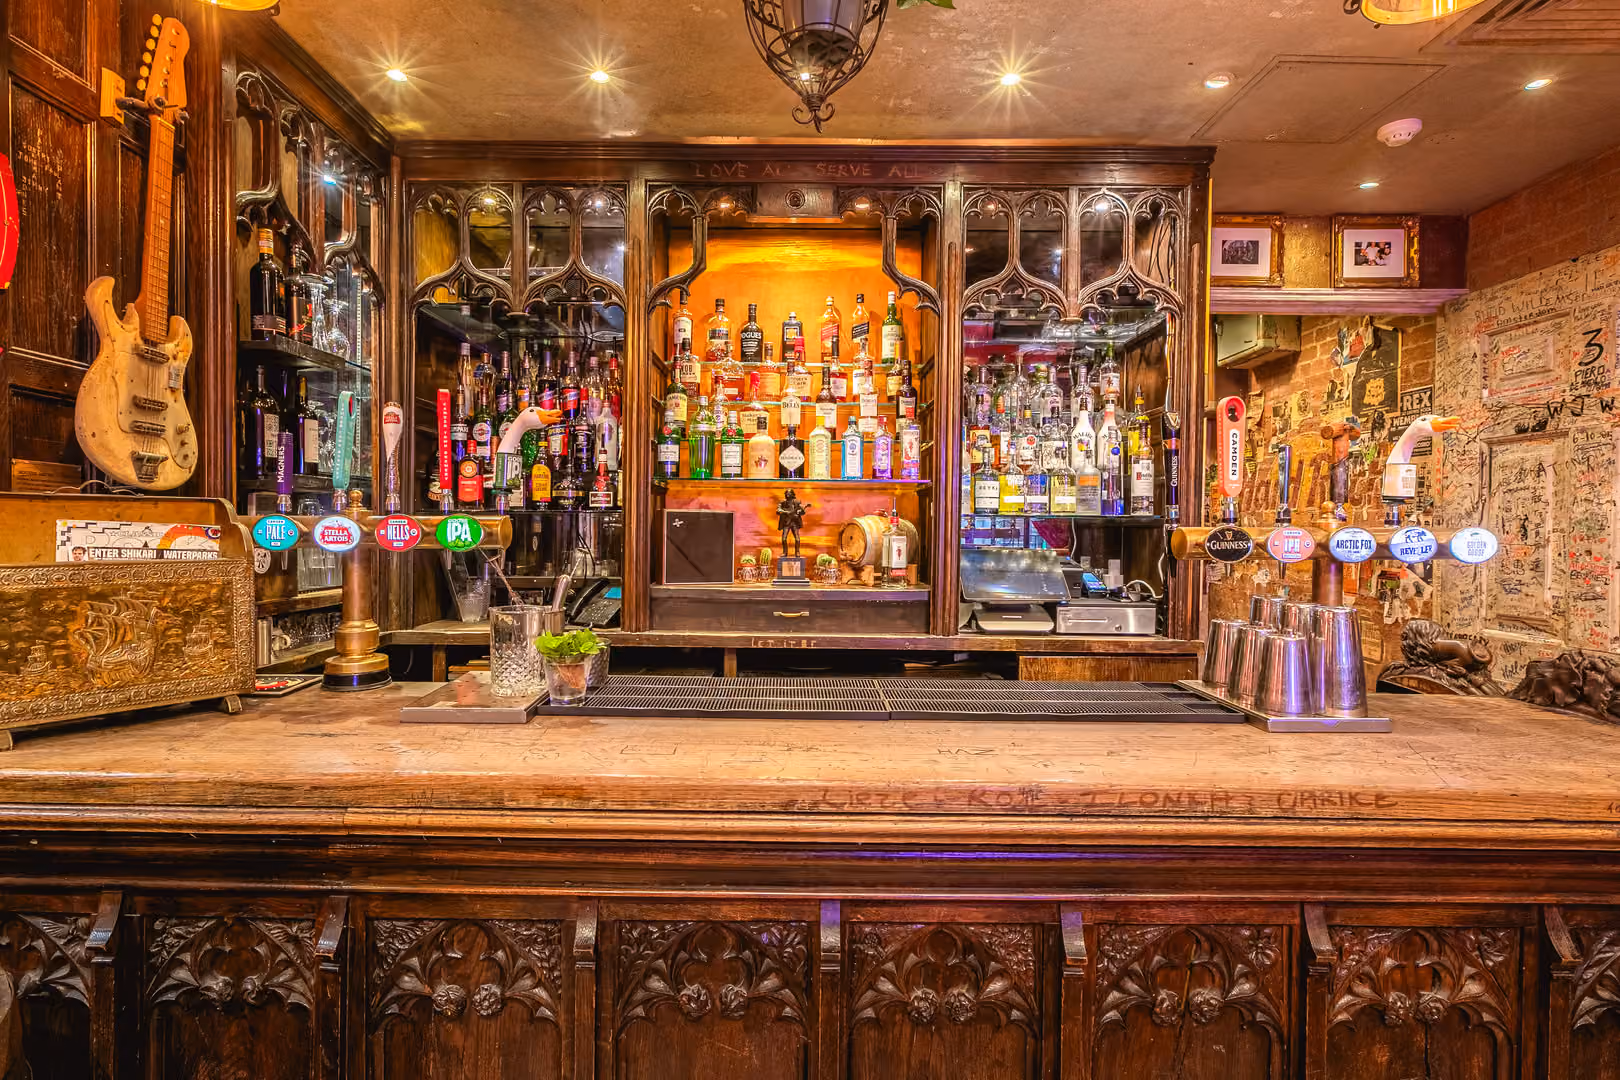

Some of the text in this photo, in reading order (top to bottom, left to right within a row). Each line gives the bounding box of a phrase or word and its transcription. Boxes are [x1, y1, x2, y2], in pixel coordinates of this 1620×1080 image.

[693, 161, 748, 178] LOVE
[816, 162, 873, 178] SERVE
[1578, 328, 1604, 366] 3
[277, 446, 285, 483] MAGNERS
[1170, 456, 1178, 487] GUINNESS
[265, 525, 287, 541] PALE
[324, 529, 349, 537] STELLA
[387, 525, 410, 541] HELLS
[446, 522, 472, 542] IPA
[1210, 540, 1250, 551] GUINNESS
[1284, 538, 1301, 553] IPA
[1335, 539, 1372, 550] ARCTIC FOX
[89, 548, 218, 561] ENTER SHIKARI WATERPARKS
